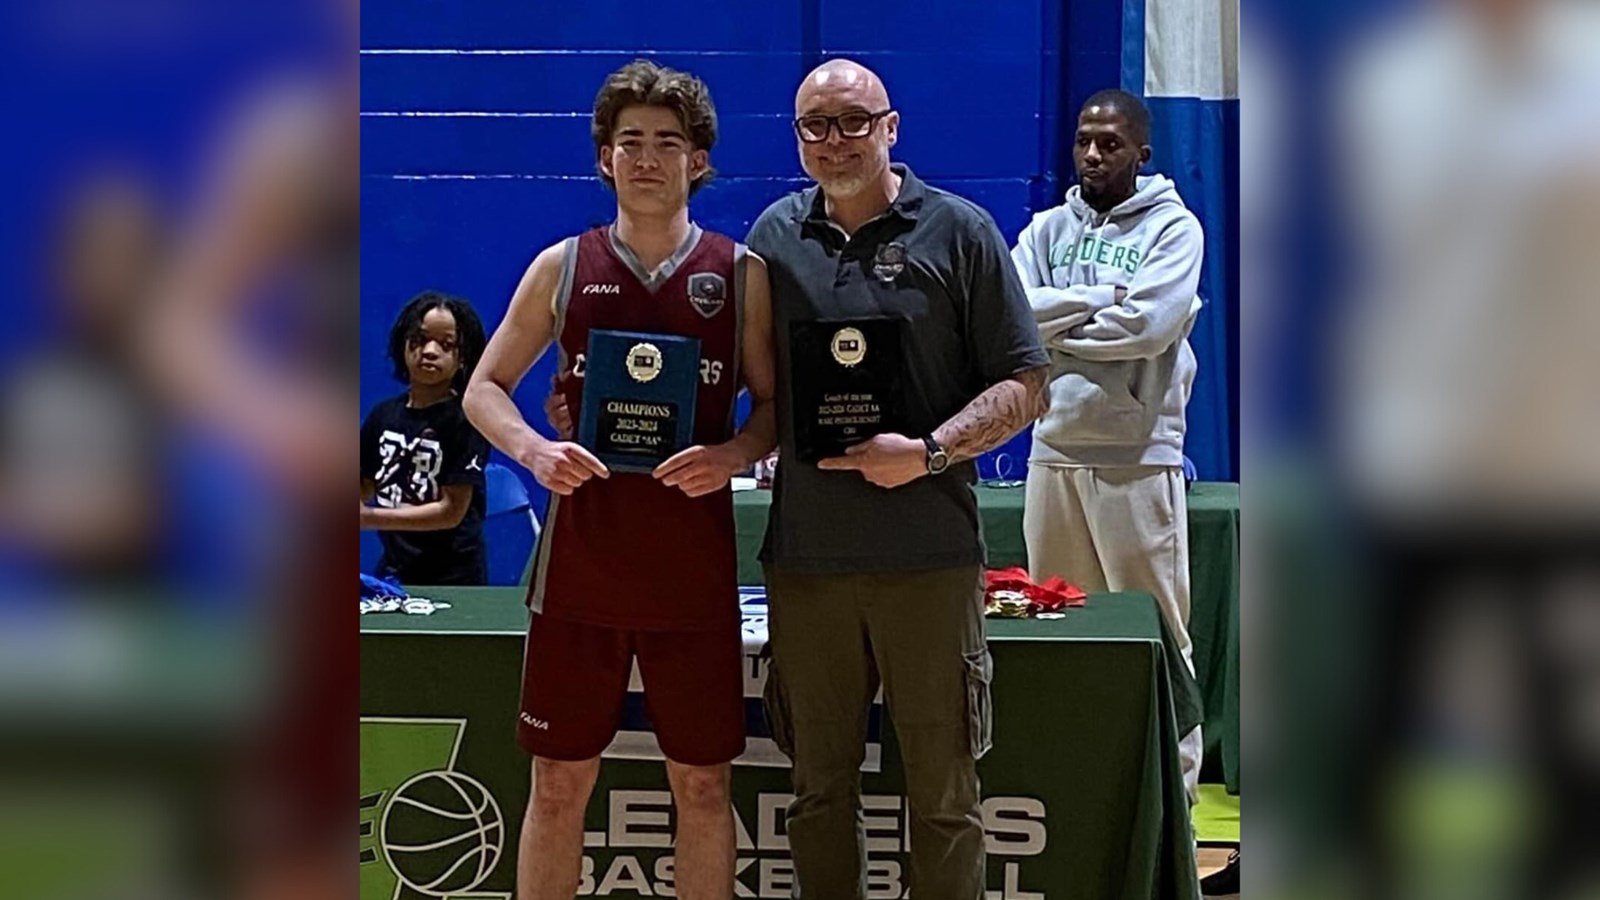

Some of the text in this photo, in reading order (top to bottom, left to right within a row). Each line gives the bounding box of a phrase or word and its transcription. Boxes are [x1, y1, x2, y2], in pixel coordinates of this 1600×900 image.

[1050, 236, 1140, 274] LEDERS
[582, 284, 621, 295] FANA
[607, 401, 671, 417] CHAMPIONS
[616, 418, 659, 432] 2023-2024
[610, 432, 641, 444] CADET
[520, 711, 549, 730] FANA
